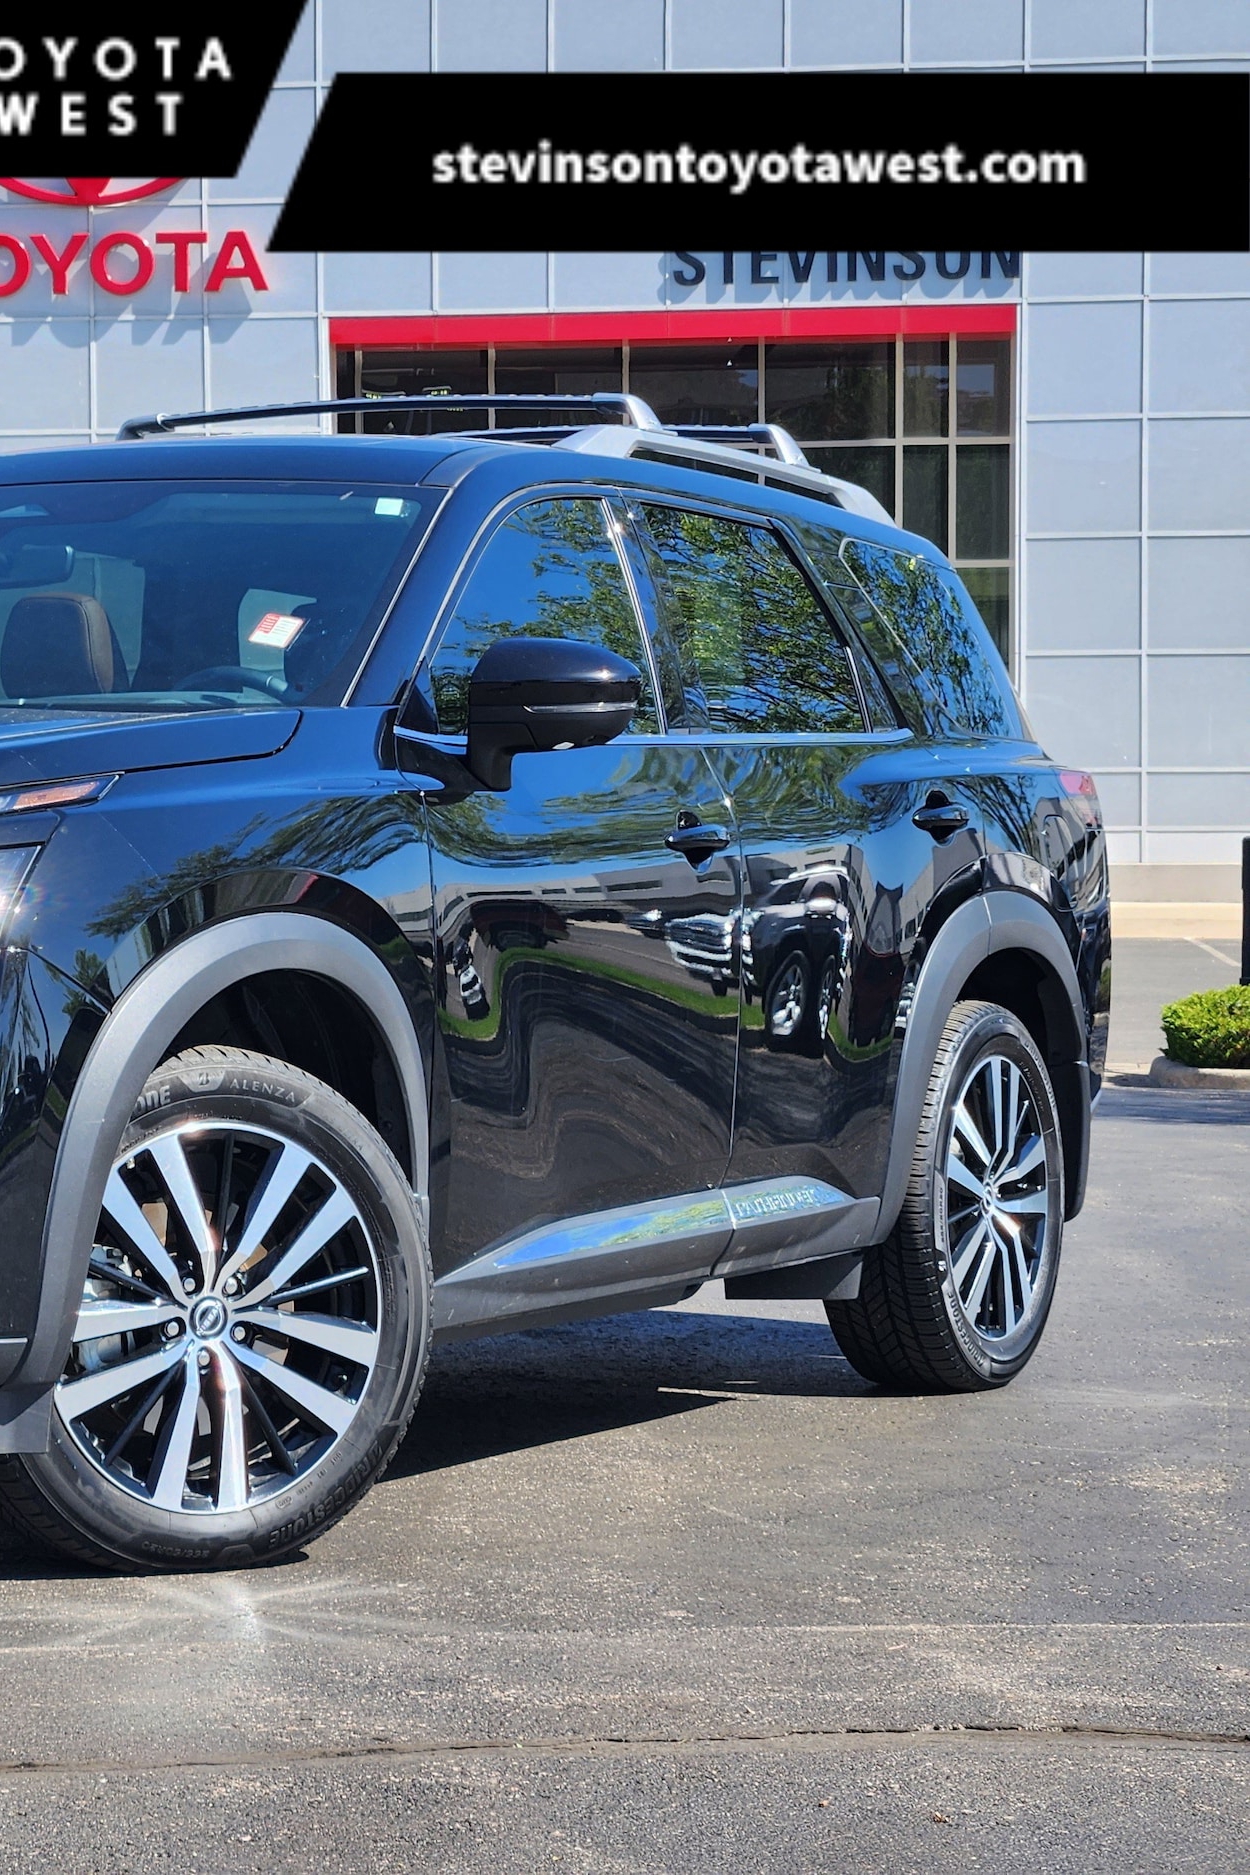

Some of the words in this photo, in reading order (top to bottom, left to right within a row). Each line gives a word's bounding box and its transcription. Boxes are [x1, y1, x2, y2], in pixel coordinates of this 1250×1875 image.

[673, 251, 1020, 286] STEVINSON
[229, 1077, 296, 1103] ALENZA
[947, 1291, 985, 1368] BRIDGESTONE
[269, 1440, 384, 1546] BRIDGESTONE
